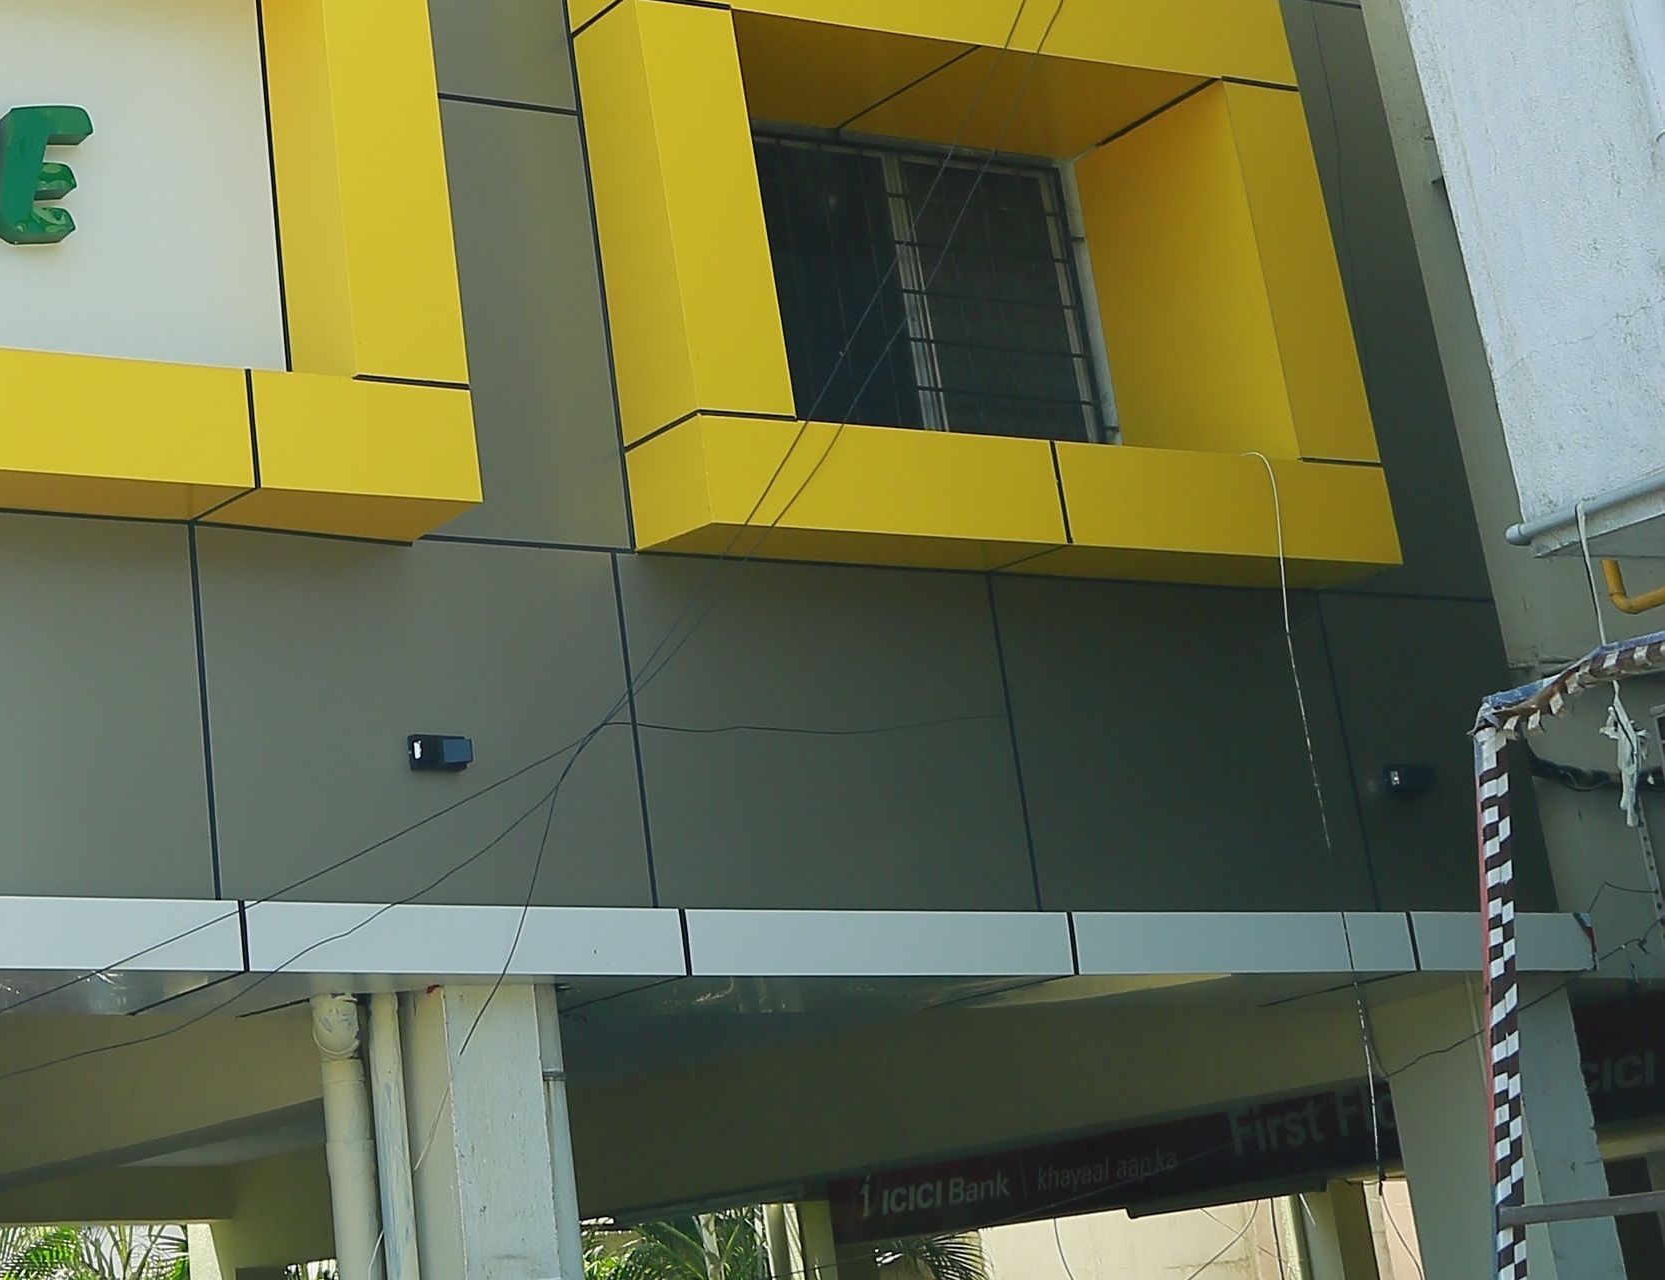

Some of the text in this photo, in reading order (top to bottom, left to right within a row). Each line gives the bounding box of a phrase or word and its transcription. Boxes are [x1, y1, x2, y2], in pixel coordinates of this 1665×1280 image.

[1228, 1098, 1325, 1156] First
[883, 1180, 943, 1215] ICICI
[949, 1172, 1011, 1205] Bank
[1038, 1155, 1110, 1192] khayaal
